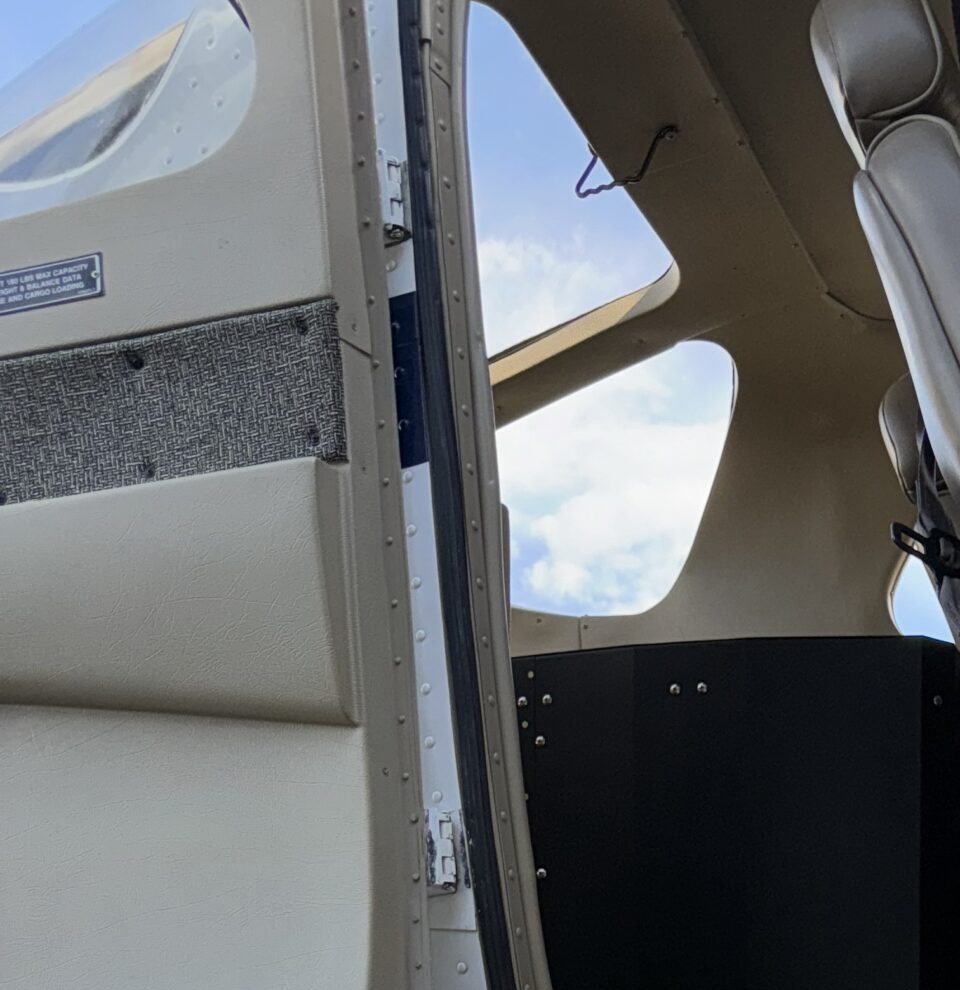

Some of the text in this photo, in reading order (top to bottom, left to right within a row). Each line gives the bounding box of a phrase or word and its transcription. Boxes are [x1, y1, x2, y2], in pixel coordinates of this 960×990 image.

[20, 274, 34, 283] LBS
[36, 271, 52, 280] MAX
[53, 263, 88, 276] CAPACITY
[26, 278, 60, 290] BALANCE
[62, 273, 82, 283] DATA
[8, 294, 24, 302] AND
[24, 288, 51, 300] CARGO
[52, 282, 84, 294] LOADING
